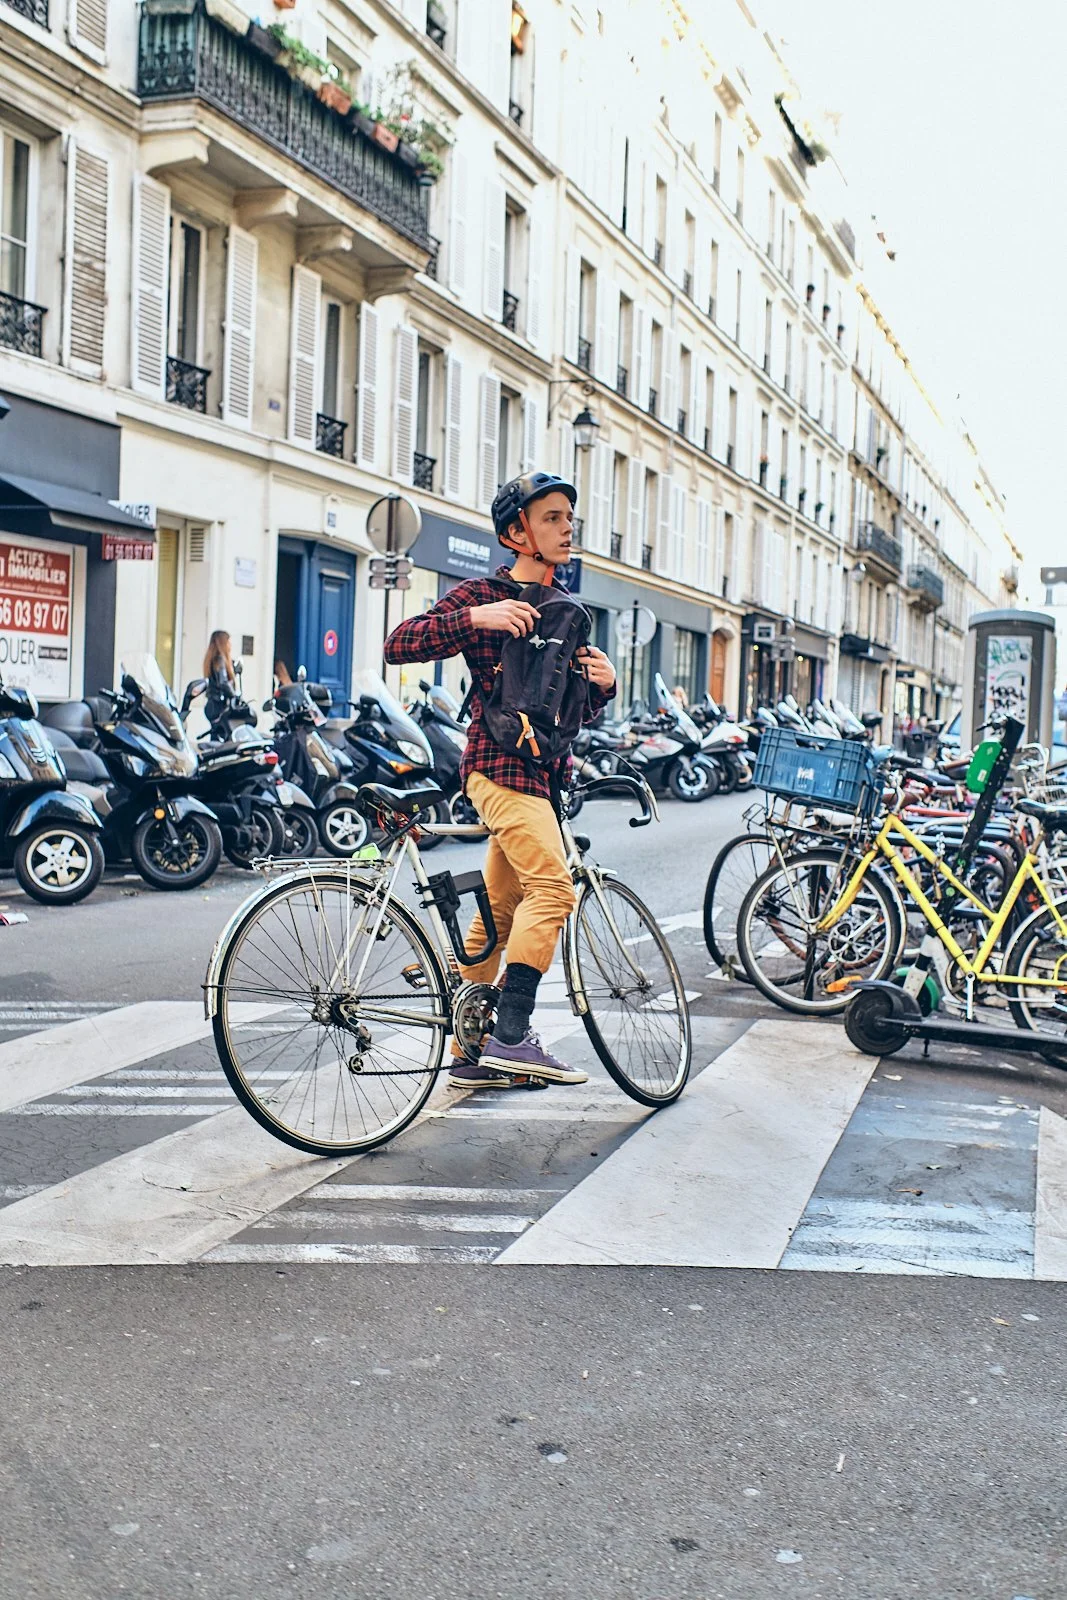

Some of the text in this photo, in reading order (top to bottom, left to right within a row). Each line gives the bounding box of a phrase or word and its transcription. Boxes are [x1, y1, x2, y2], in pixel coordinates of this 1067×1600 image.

[8, 548, 45, 568] ACTIFS
[8, 564, 67, 585] IMMOBILIER
[14, 600, 31, 628] 03
[33, 602, 50, 629] 97
[52, 605, 68, 631] 07
